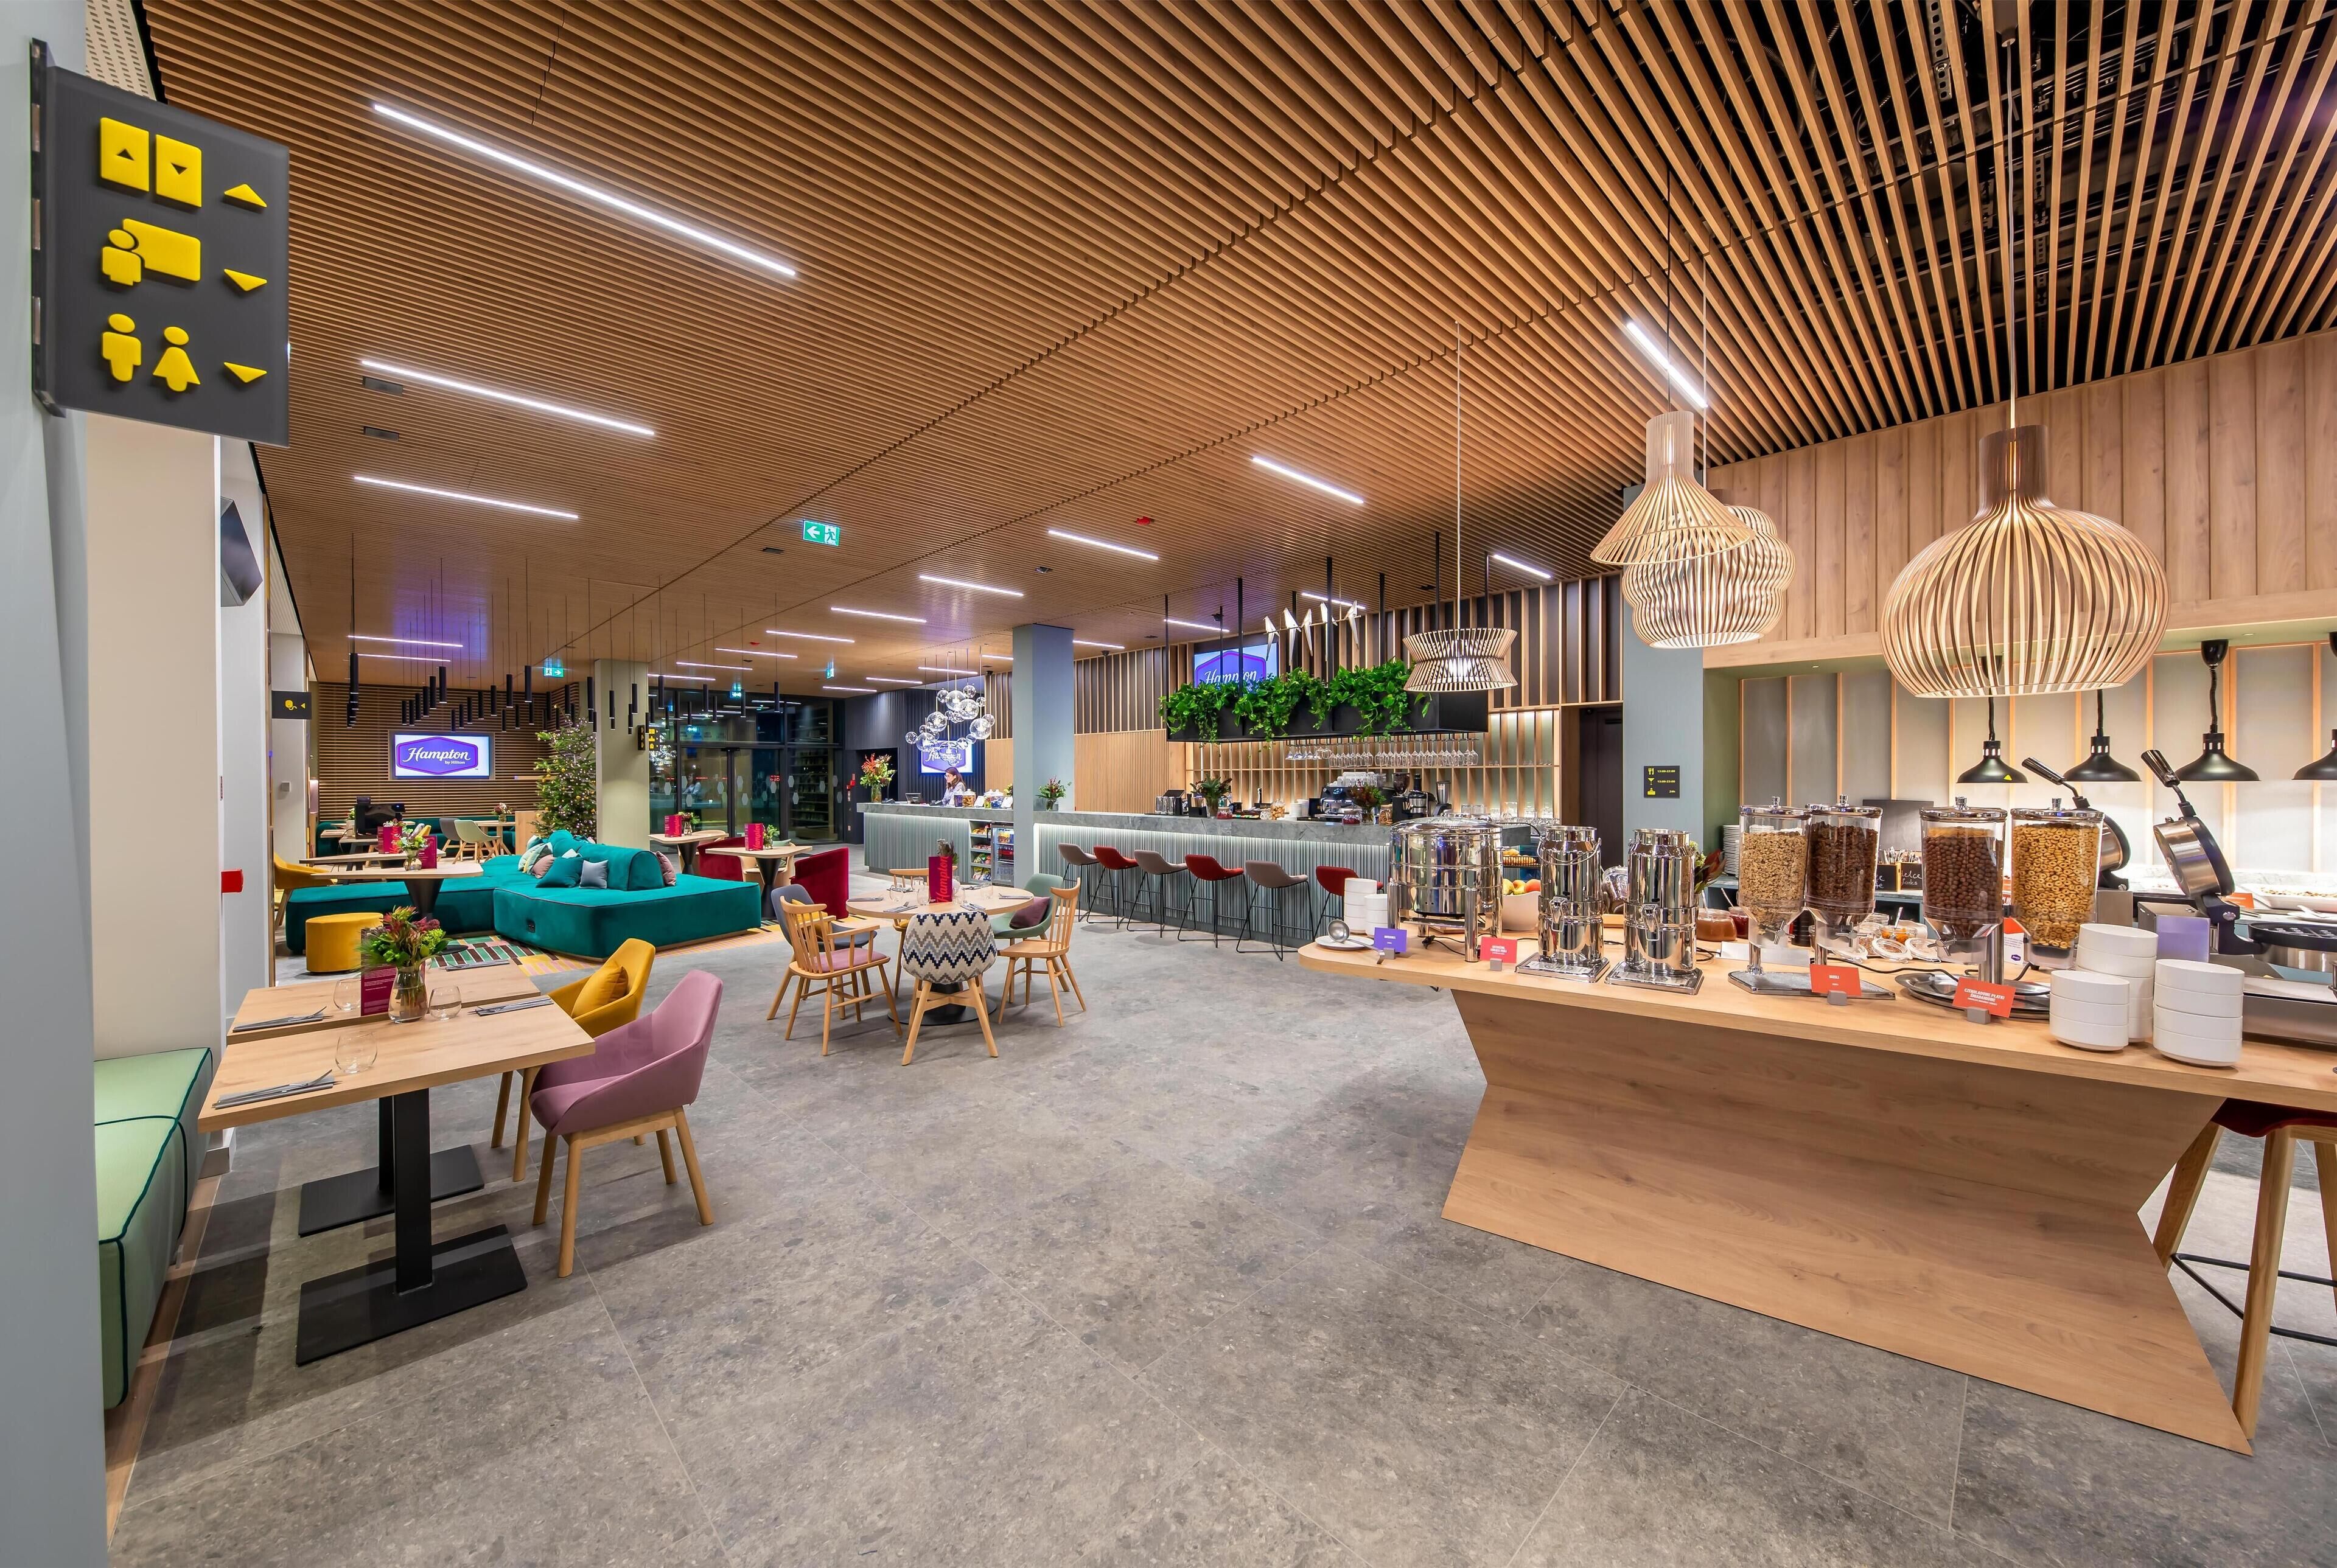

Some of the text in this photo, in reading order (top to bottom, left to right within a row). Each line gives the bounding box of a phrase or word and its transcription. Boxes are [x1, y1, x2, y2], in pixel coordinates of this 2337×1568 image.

[1204, 668, 1260, 684] Hampon
[402, 747, 471, 762] Hampton
[935, 856, 951, 903] Hampton
